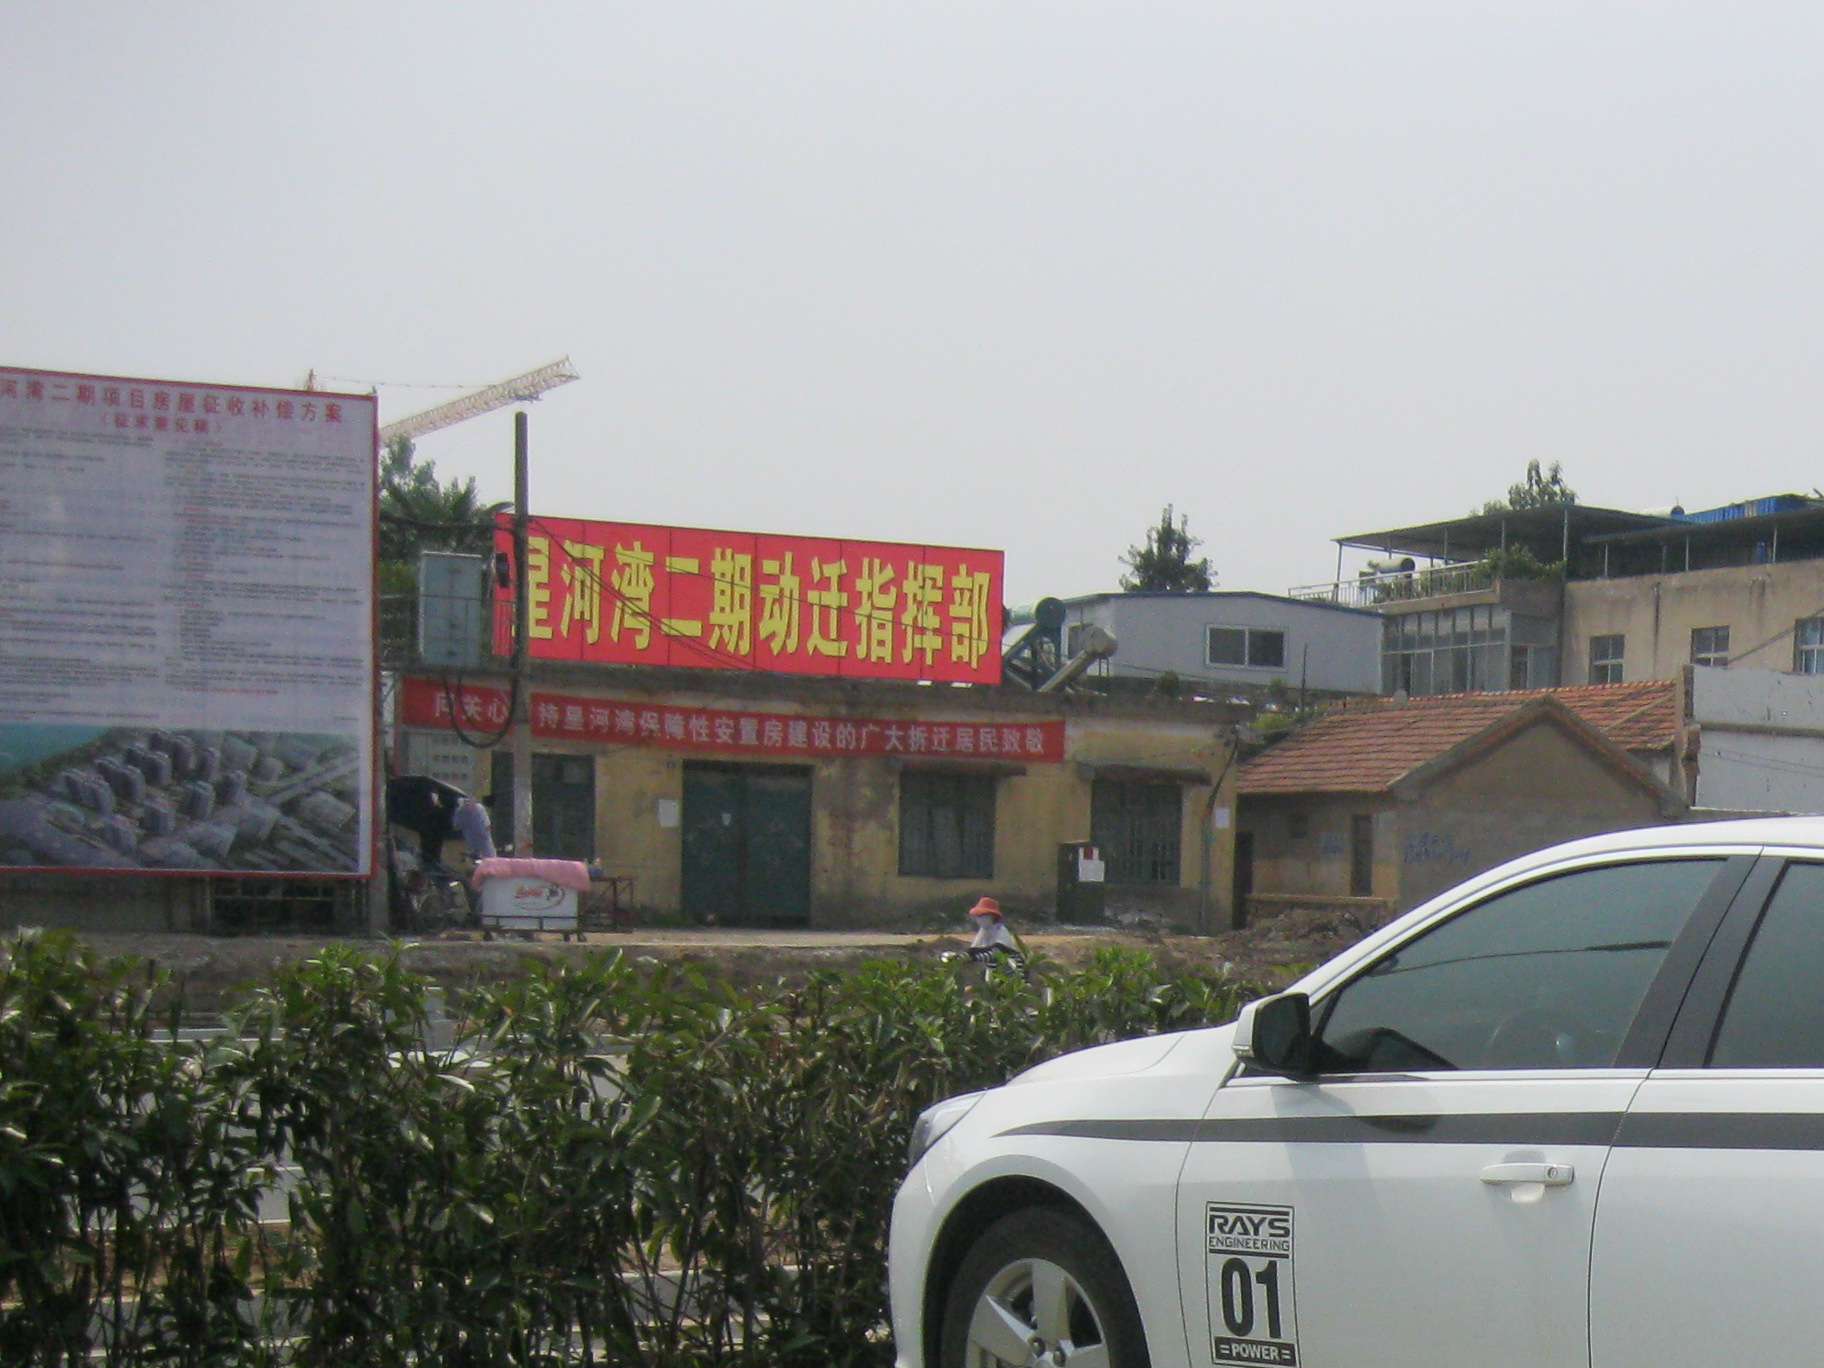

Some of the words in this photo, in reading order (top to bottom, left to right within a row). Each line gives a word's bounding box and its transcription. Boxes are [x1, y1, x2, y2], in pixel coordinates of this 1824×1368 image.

[512, 536, 990, 670] 星河湾二期动迁指挥部
[1208, 1214, 1291, 1238] RAYS
[1208, 1236, 1291, 1252] ENGINEERING
[1221, 1256, 1282, 1340] 01
[1231, 1342, 1280, 1361] POWER
